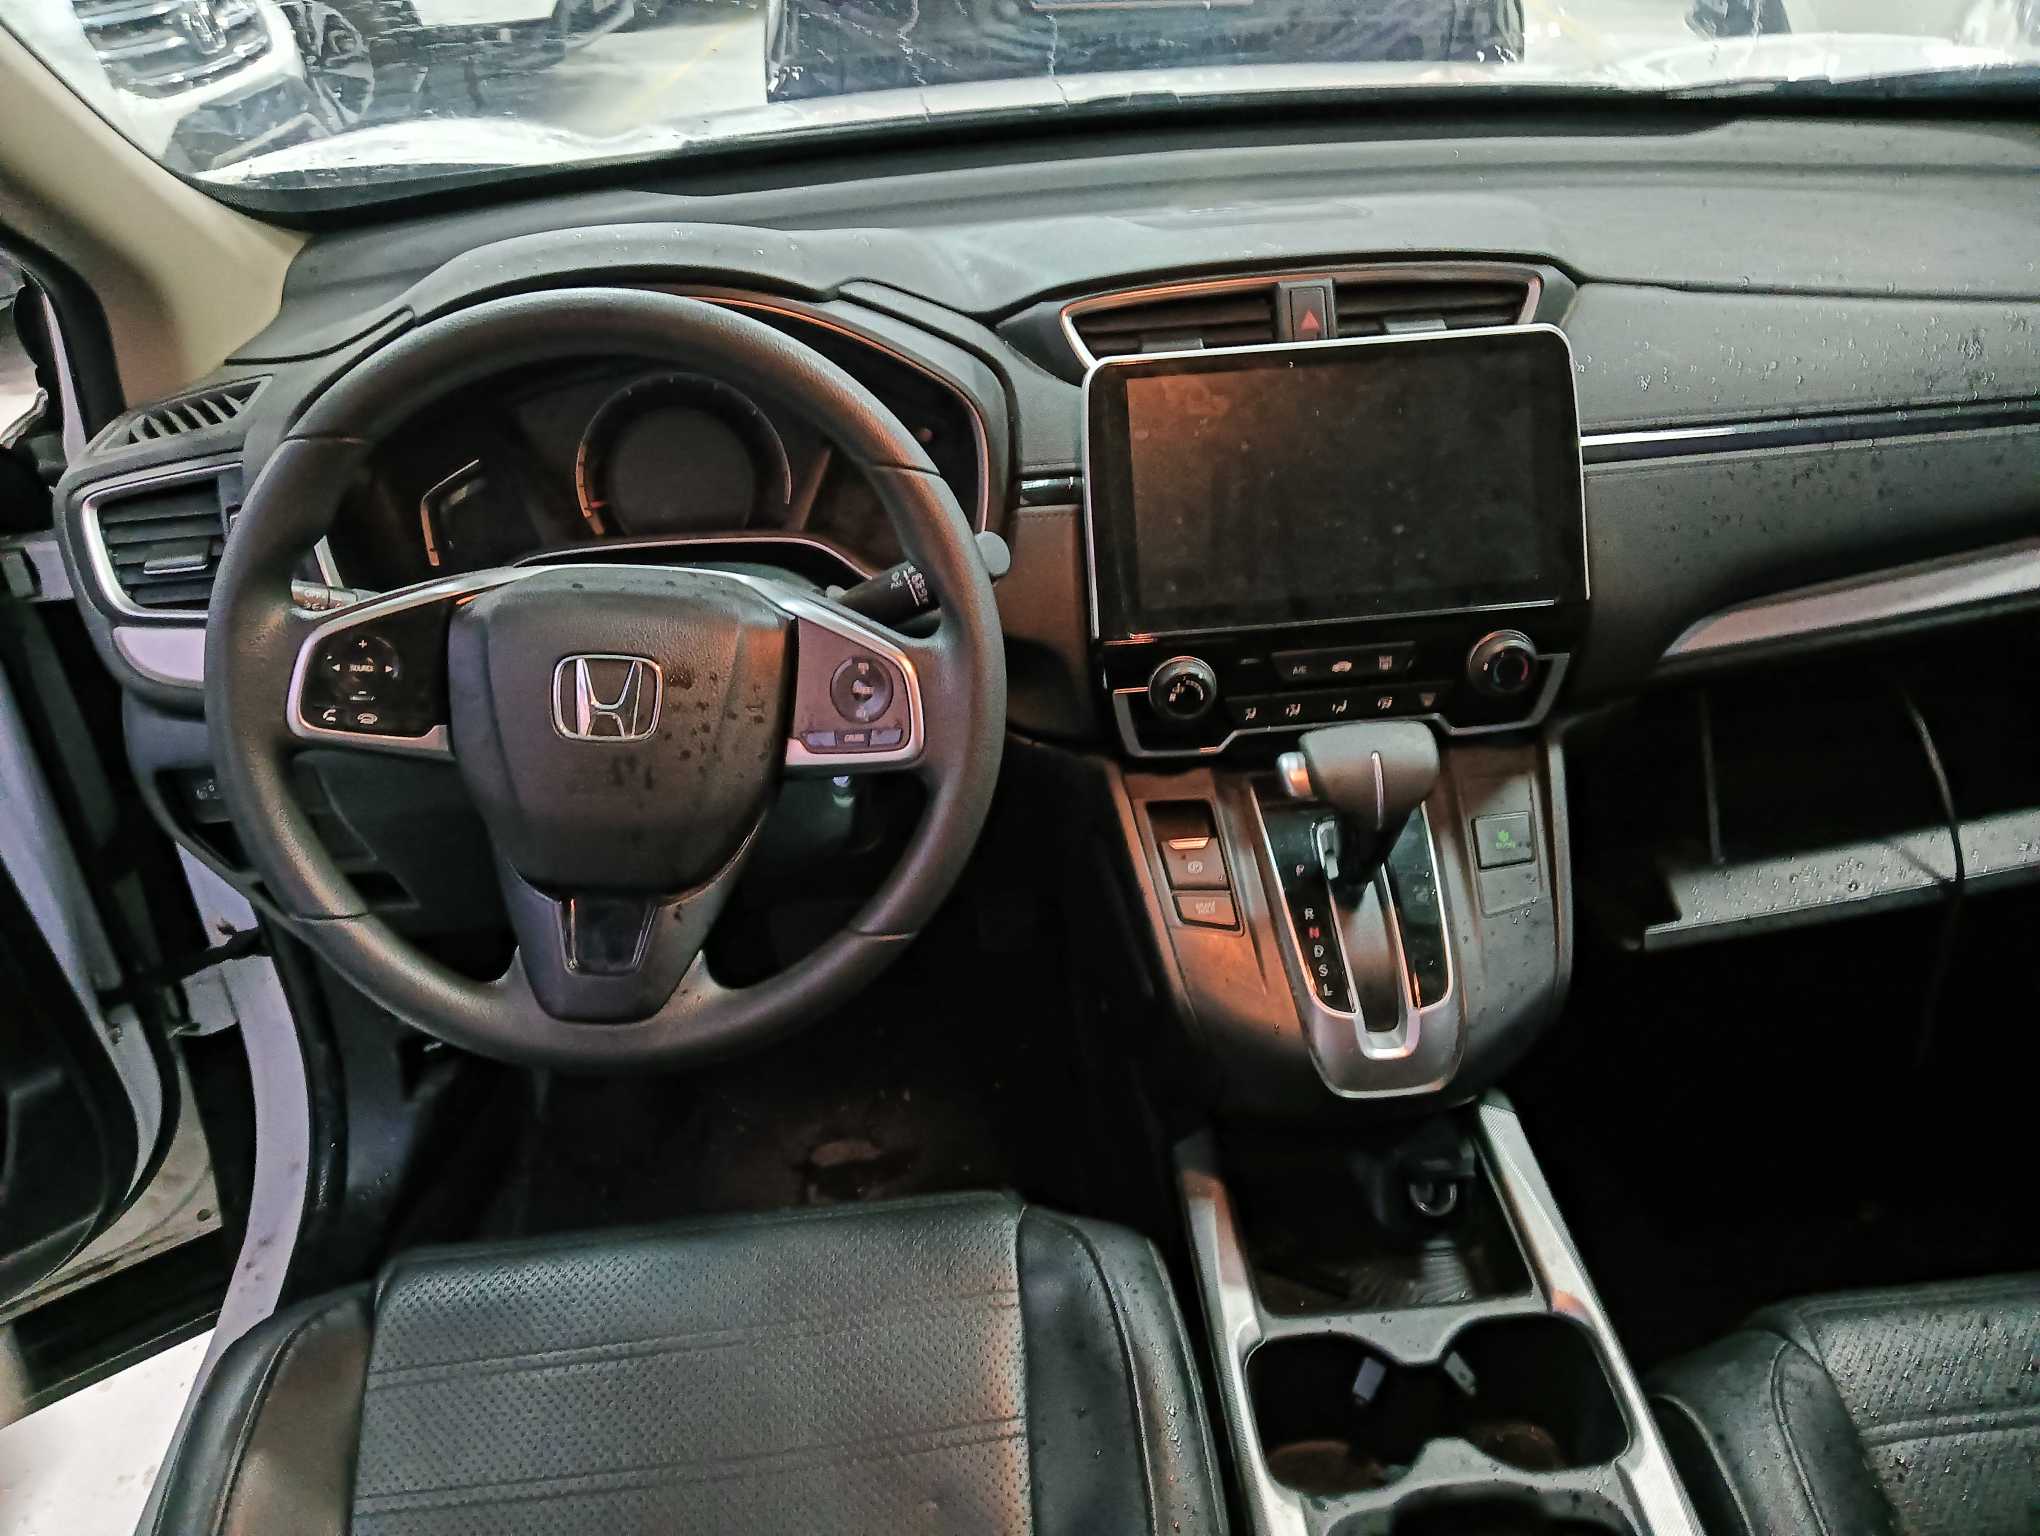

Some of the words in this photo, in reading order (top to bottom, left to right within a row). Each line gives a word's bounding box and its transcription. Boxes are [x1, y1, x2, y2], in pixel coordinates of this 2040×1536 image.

[1296, 864, 1304, 876] P
[1304, 908, 1314, 920] R
[1314, 944, 1324, 957] D
[1319, 964, 1328, 976] S
[1323, 984, 1333, 996] L
